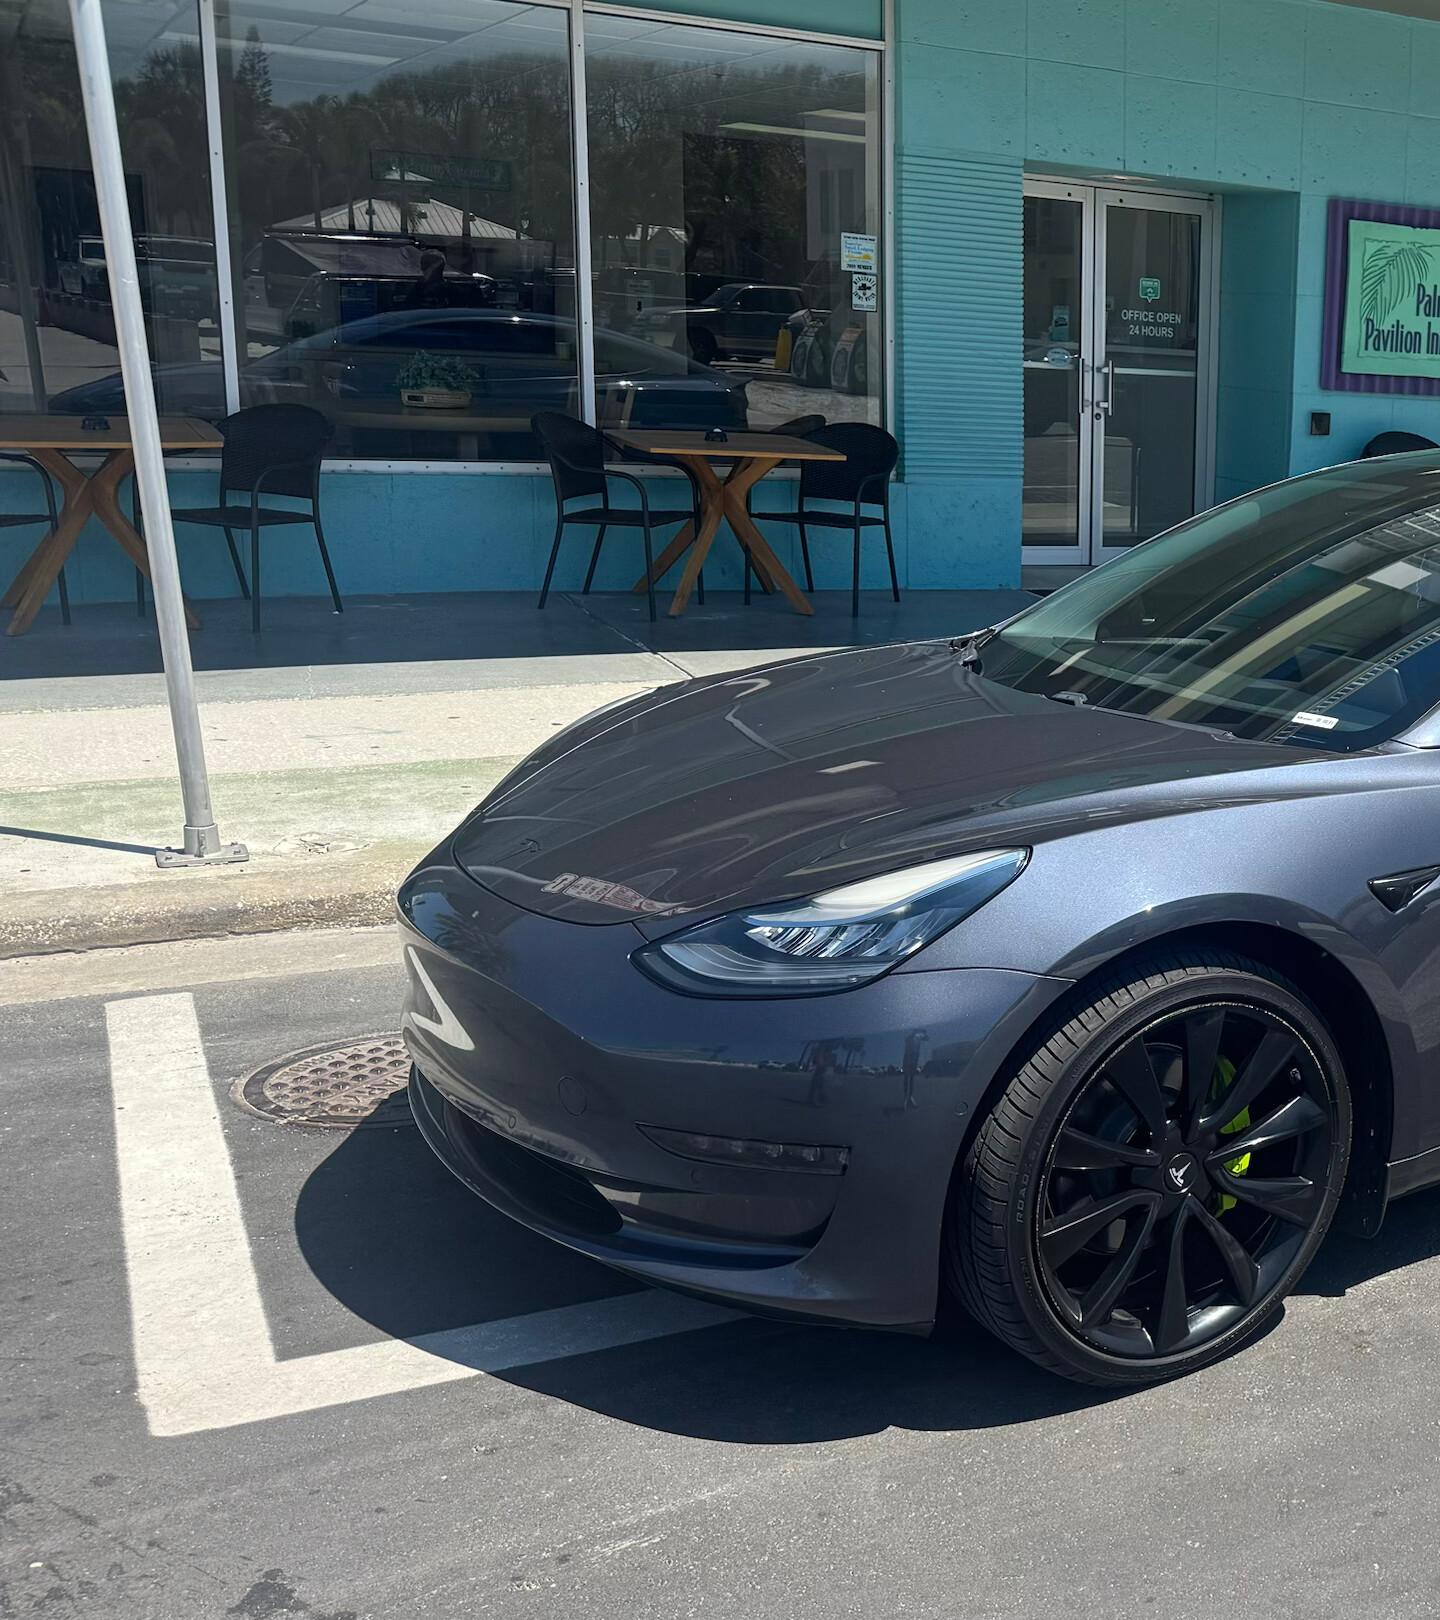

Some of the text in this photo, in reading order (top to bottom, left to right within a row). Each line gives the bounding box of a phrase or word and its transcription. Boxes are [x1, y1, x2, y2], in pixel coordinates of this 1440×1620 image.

[1121, 309, 1181, 324] OFFICE OPEN
[1129, 324, 1174, 338] 24 HOURS
[1364, 318, 1422, 354] Pavilion
